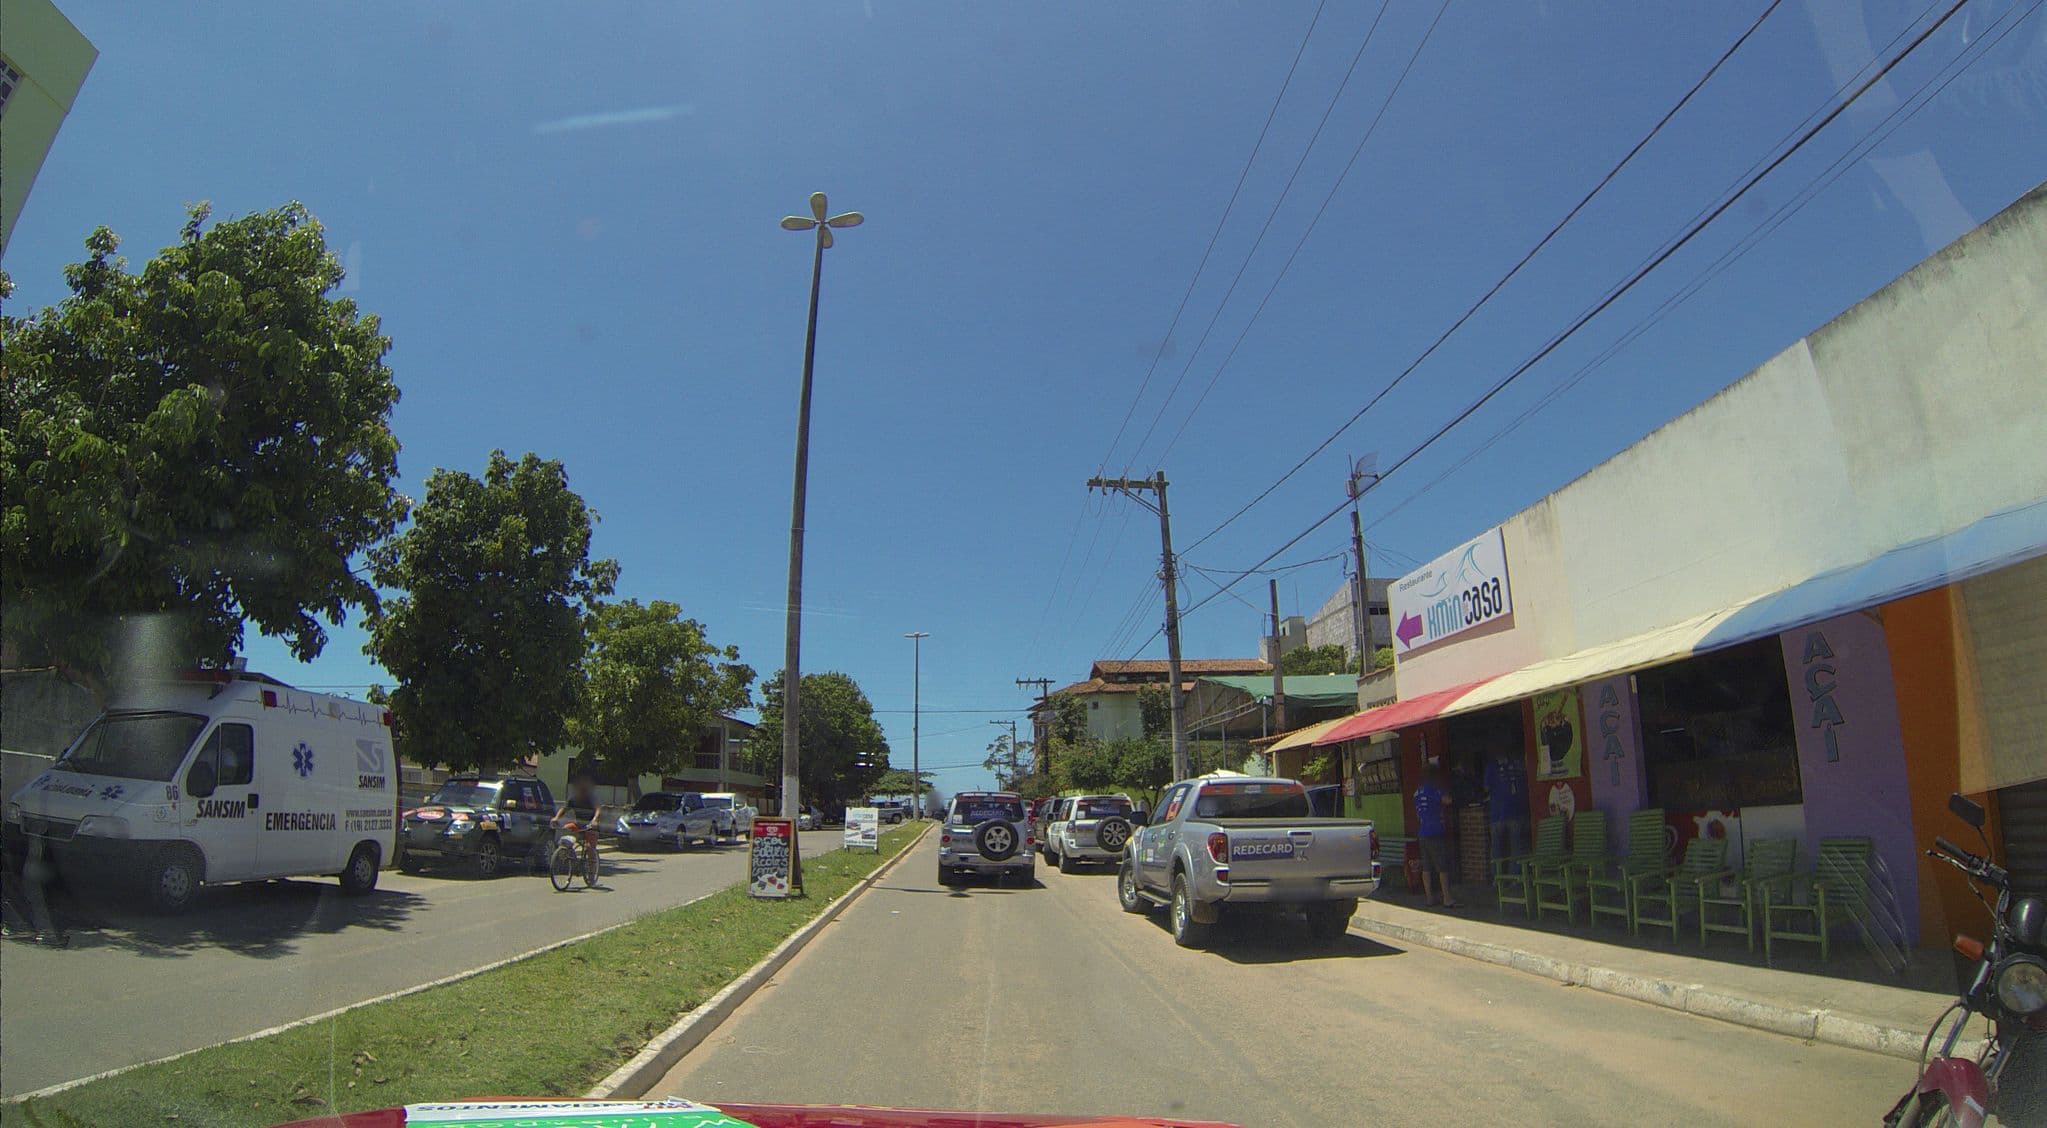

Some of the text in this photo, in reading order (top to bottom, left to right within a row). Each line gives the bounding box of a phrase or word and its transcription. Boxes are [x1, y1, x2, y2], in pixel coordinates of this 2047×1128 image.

[1399, 569, 1433, 592] Restaurante
[358, 775, 385, 789] SANSIM
[166, 785, 179, 801] 86
[196, 800, 246, 818] SANSIM
[265, 809, 336, 832] EMERGÊNCIA
[1233, 844, 1293, 856] REDECARD
